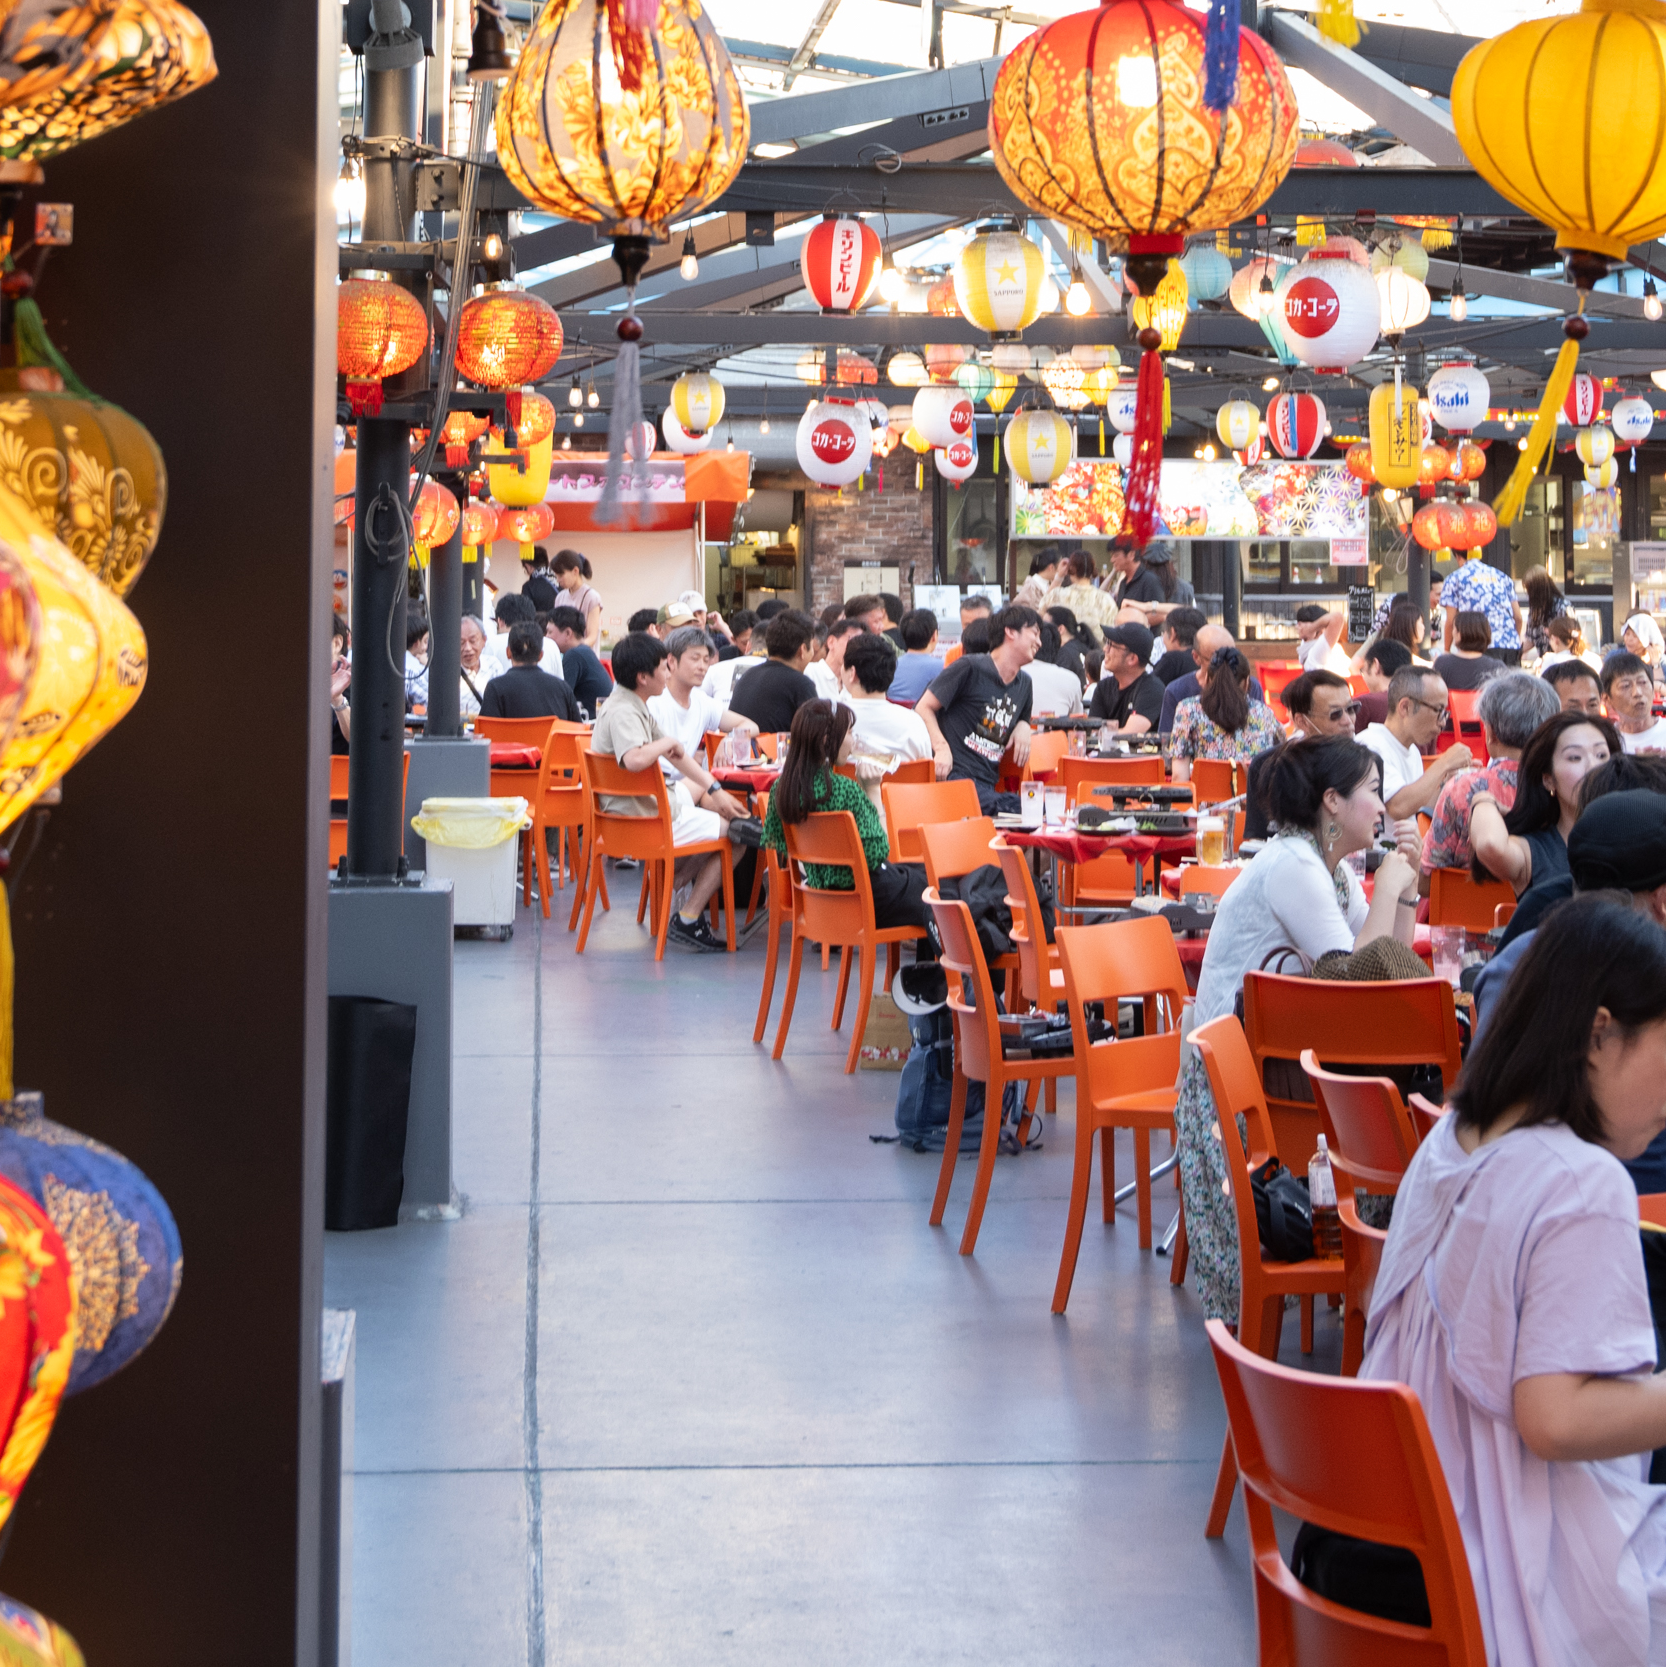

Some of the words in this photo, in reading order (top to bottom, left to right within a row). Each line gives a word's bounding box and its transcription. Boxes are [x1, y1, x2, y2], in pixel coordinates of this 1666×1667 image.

[836, 228, 855, 294] キリンビール
[993, 288, 1024, 297] SAPPORO
[1285, 297, 1339, 318] コカ・コーラ
[1432, 391, 1470, 408] Asahi
[812, 431, 856, 452] コカ・コーラ
